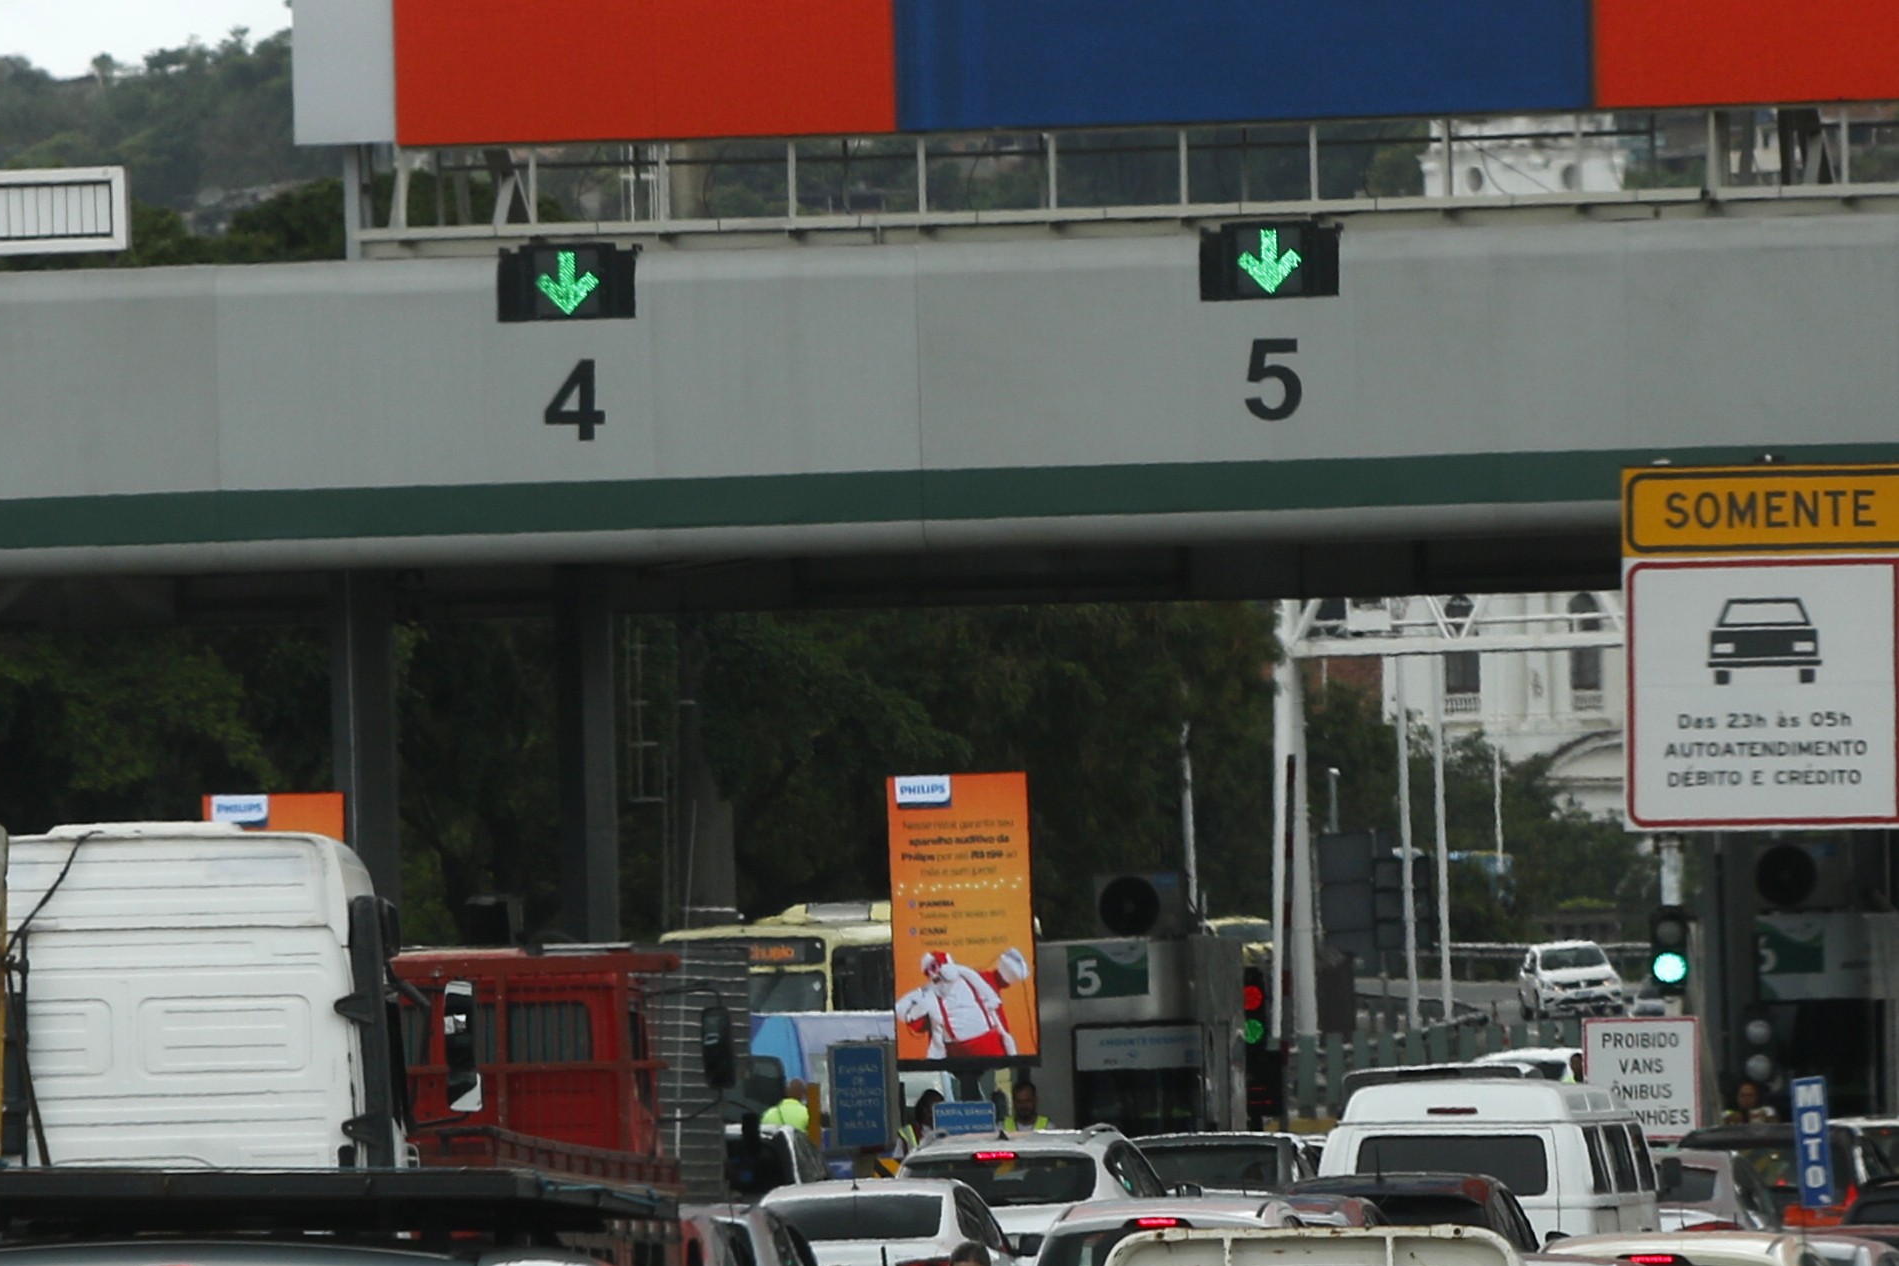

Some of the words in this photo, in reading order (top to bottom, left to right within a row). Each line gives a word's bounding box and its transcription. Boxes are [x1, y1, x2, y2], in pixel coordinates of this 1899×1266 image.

[1244, 338, 1303, 421] 5
[544, 359, 605, 441] 4
[1664, 489, 1877, 529] SOMENTE
[1677, 713, 1717, 729] Das
[1727, 713, 1767, 729] 23h
[1810, 711, 1853, 727] 05h
[1664, 740, 1868, 759] AUTOATENDIMENTO
[1667, 767, 1742, 787] DÉBITO
[1752, 771, 1766, 786] E
[1774, 764, 1862, 786] CRÉDITO
[900, 784, 946, 796] PHILIPS
[1076, 958, 1102, 997] 5
[1602, 1032, 1680, 1049] PROIBIDO
[1618, 1058, 1664, 1075] VANS
